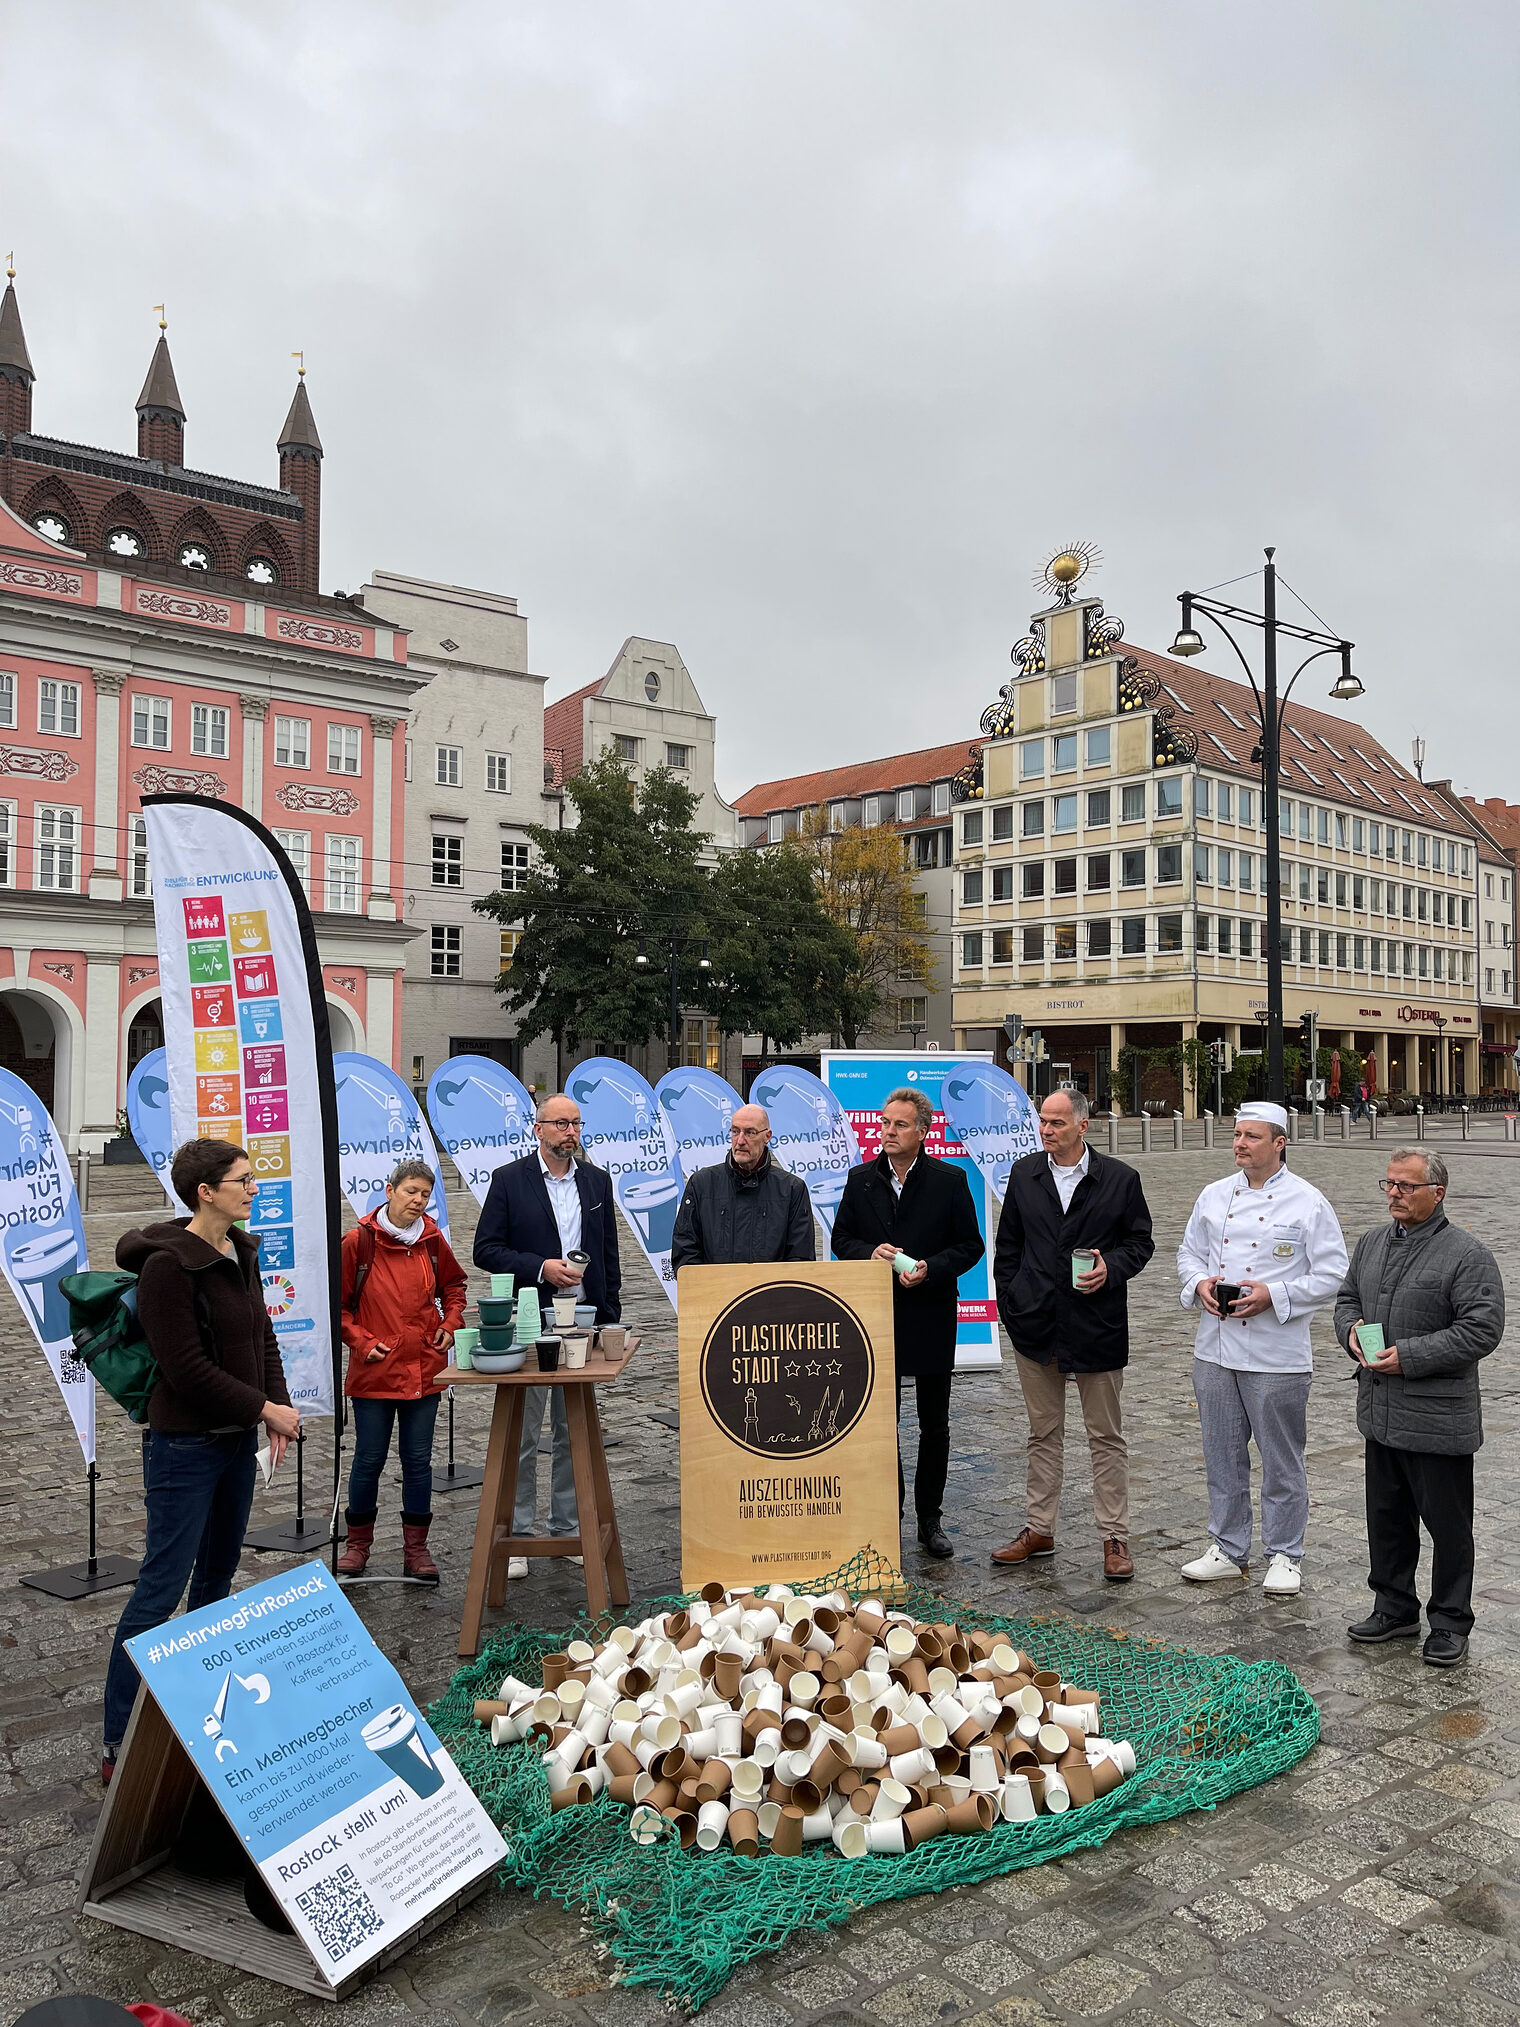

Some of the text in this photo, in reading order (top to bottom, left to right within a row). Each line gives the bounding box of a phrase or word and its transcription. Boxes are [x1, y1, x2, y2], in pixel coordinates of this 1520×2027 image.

[197, 869, 279, 886] ENTWICKLUNG
[185, 901, 190, 910] 1
[232, 916, 238, 926] 2
[191, 946, 197, 955] 3
[237, 960, 243, 970] 4
[195, 990, 201, 1000] 5
[1046, 1000, 1085, 1010] BISTROT
[242, 1006, 248, 1015] 6
[198, 1034, 204, 1043] 7
[458, 1041, 490, 1049] RTSAMT
[246, 1050, 253, 1060] 8
[199, 1079, 205, 1088] 9
[248, 1095, 258, 1105] 10
[200, 1124, 208, 1134] 11
[250, 1141, 259, 1151] 12
[924, 1144, 967, 1155] chen
[732, 1322, 841, 1353] PLASTIKFREIE
[732, 1356, 780, 1385] STADT
[739, 1475, 841, 1503] AUSZEICHNUNG
[739, 1501, 842, 1520] FÜR BEWUSSTES HANDELN
[751, 1550, 832, 1564] WWW.PLASTIKFREIESTADT.ORG
[147, 1576, 328, 1664] #MehrwegFürRostock
[202, 1602, 336, 1672] 800 Einwegbecher
[256, 1618, 343, 1665] werden stündlich
[283, 1632, 350, 1672] in Rostock für
[290, 1664, 325, 1687] Kaffee
[315, 1659, 373, 1692] verbraucht.
[224, 1696, 374, 1789] Ein Mehrwegbecher
[236, 1732, 351, 1805] kann bis zu 1.000 Mal
[248, 1753, 356, 1824] gespült und wieder-
[257, 1769, 362, 1838] verwendet werden.
[277, 1789, 408, 1883] Rostock stellt um!
[358, 1790, 458, 1860] In Rostock gibt es schon an mehr
[372, 1804, 458, 1867] als 60 Standorten Mehrweg-
[366, 1806, 477, 1886] Verpackungen für Essen und Trinken
[406, 1864, 419, 1875] Wo
[418, 1850, 441, 1868] genau,
[440, 1840, 452, 1851] das
[451, 1828, 468, 1844] zeigt
[466, 1821, 476, 1832] die
[390, 1832, 482, 1903] Rostocker Mehrweg-Map unter
[404, 1847, 484, 1909] mehrwegfürdeinestadt.org
